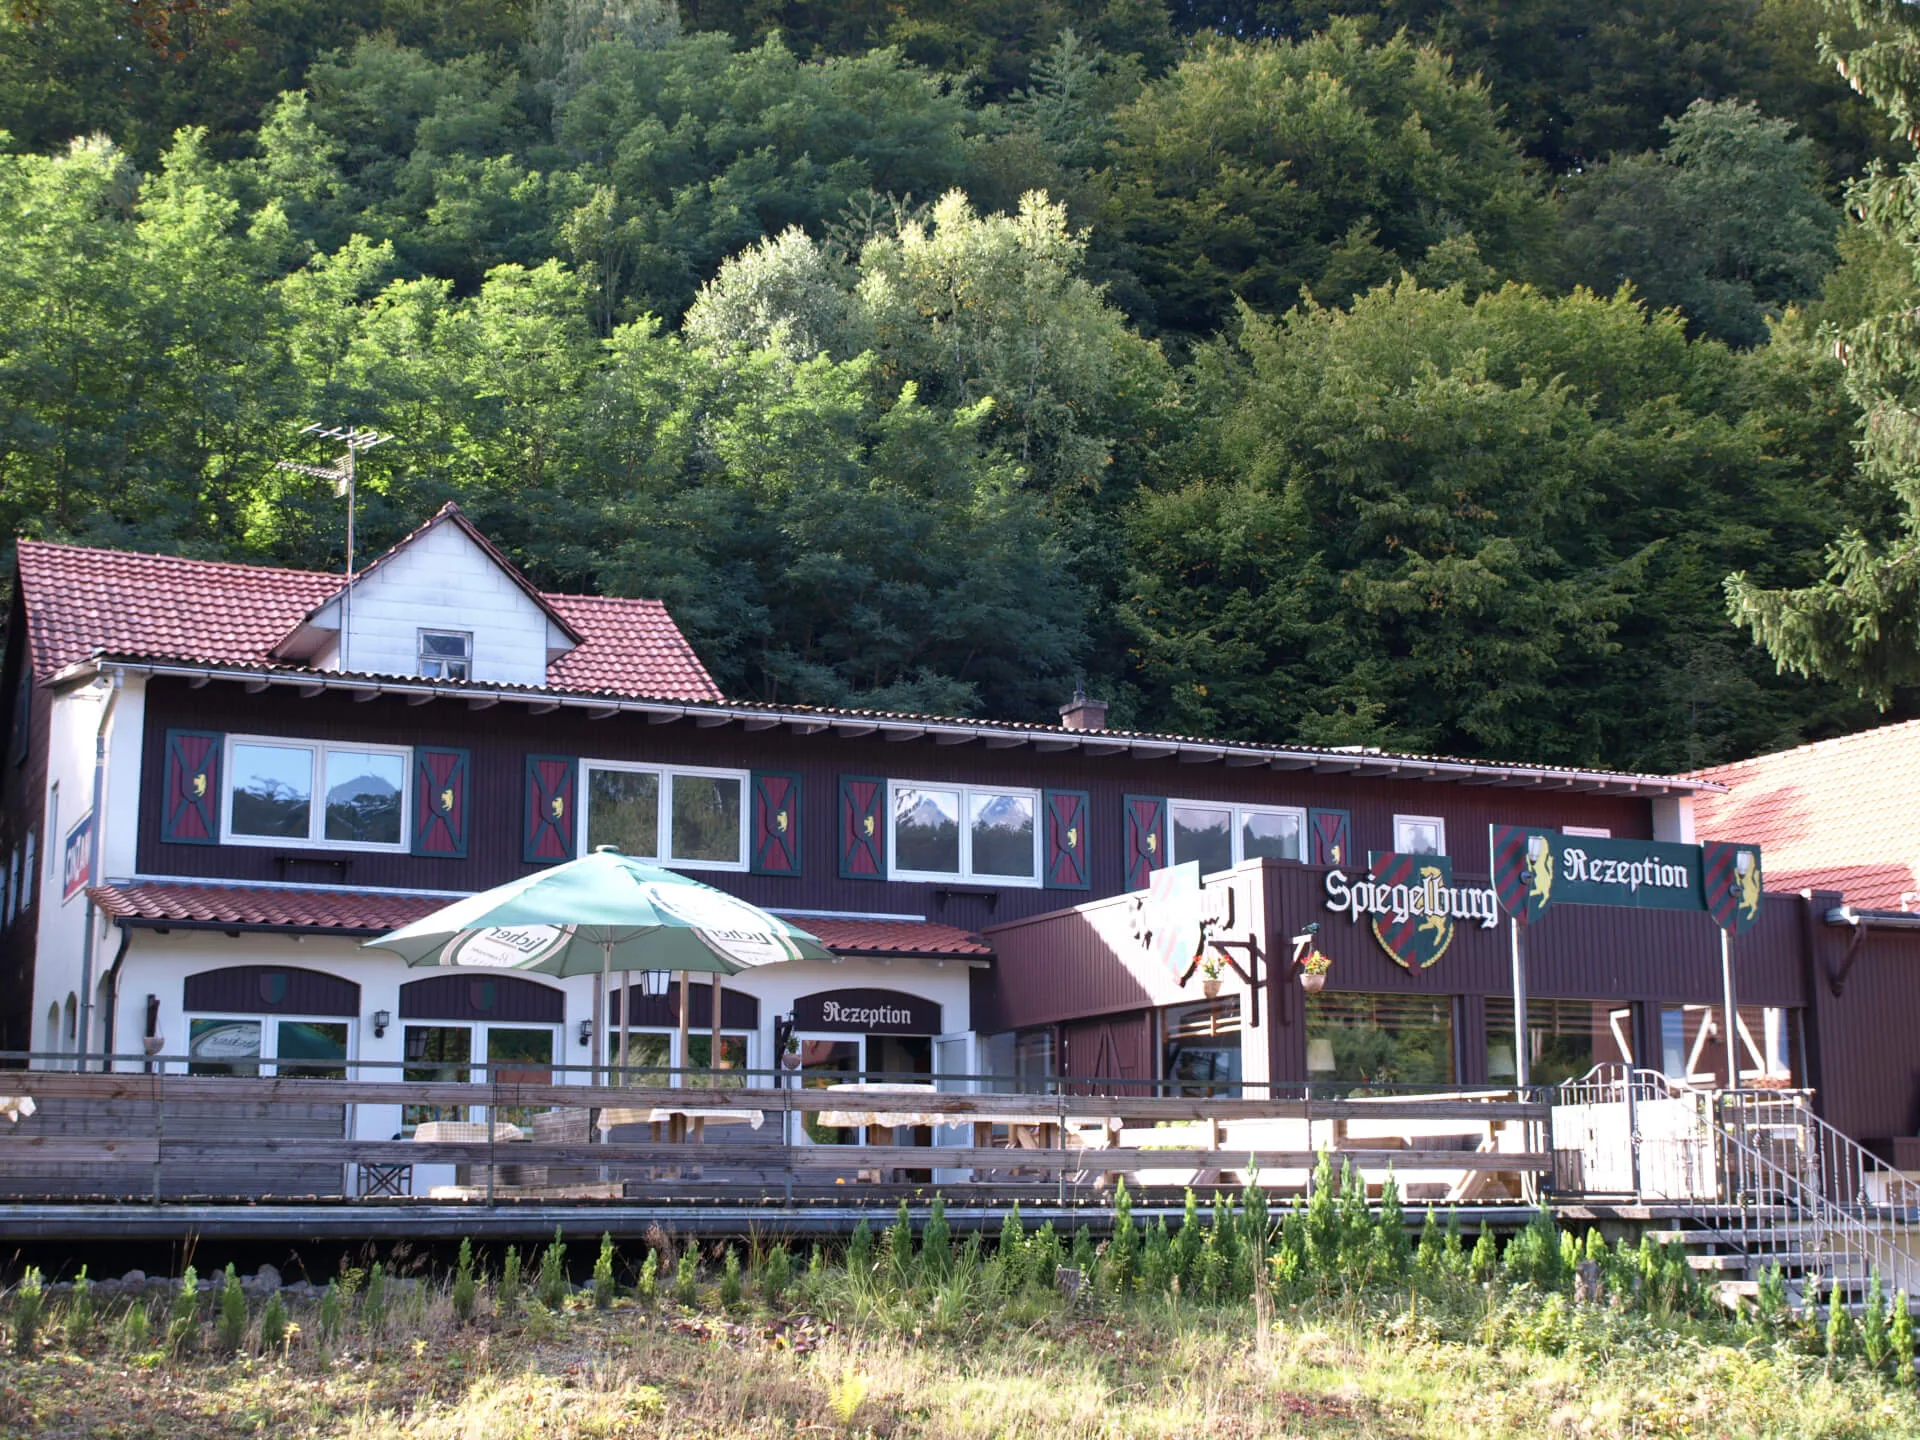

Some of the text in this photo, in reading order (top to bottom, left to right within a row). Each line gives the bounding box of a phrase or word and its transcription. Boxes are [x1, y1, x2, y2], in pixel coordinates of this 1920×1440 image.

[1563, 847, 1688, 892] Rezeption
[1326, 869, 1498, 928] Spiegelburg
[823, 1001, 912, 1028] Rezeption
